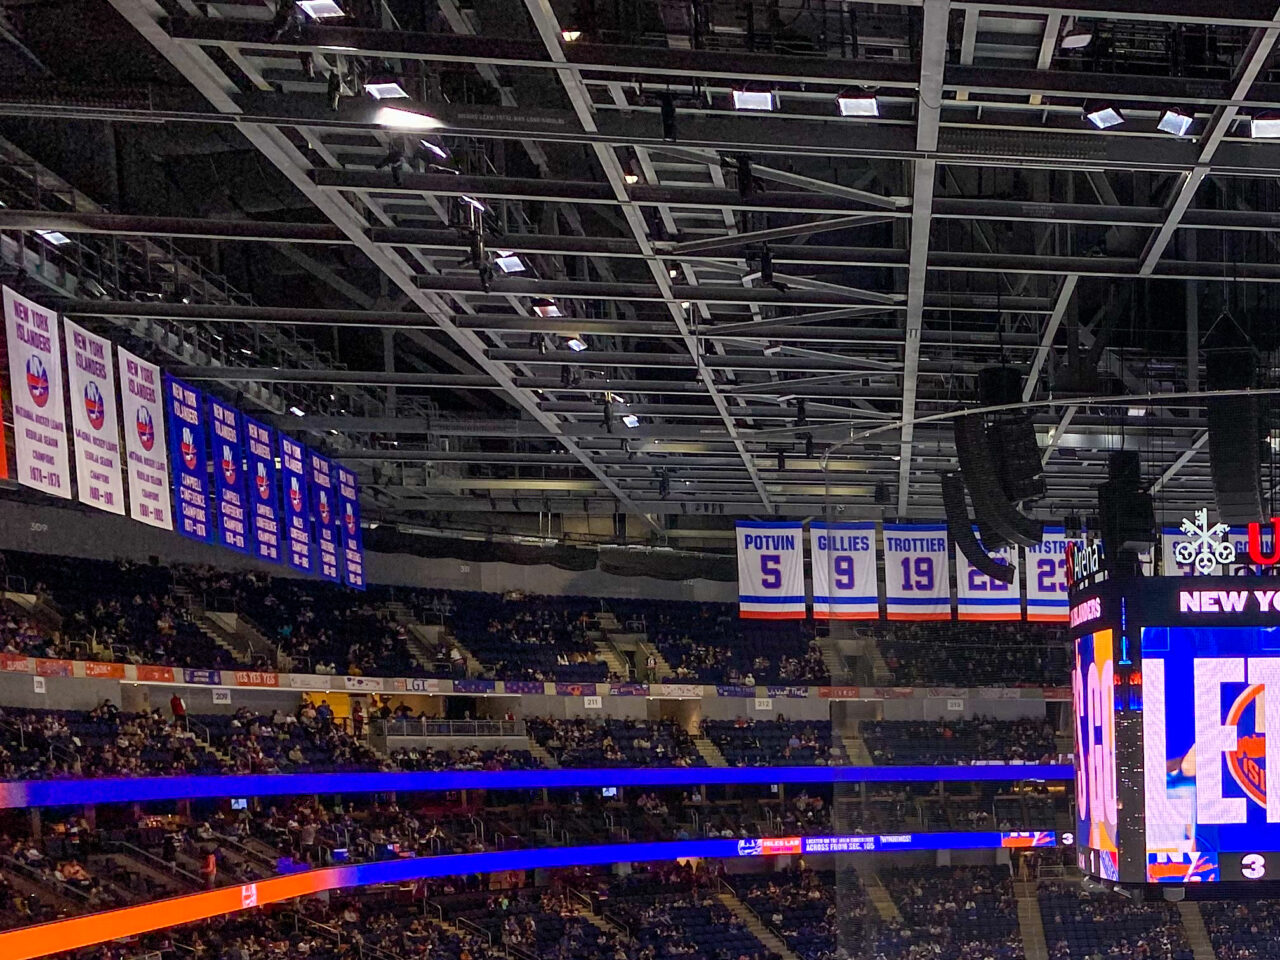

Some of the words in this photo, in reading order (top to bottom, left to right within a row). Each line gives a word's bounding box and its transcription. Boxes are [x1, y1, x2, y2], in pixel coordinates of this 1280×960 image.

[14, 299, 29, 322] NEW
[31, 309, 49, 332] YORK
[16, 322, 51, 354] ISLANDERS
[73, 330, 86, 352] NEW
[88, 339, 104, 360] YORK
[75, 351, 107, 380] ISLANDERS
[126, 358, 138, 378] NEW
[140, 365, 155, 386] YORK
[128, 377, 156, 404] ISLANDERS
[744, 534, 795, 552] POTVIN
[817, 535, 870, 552] GILLIES
[887, 537, 946, 553] TROTTIER
[760, 554, 781, 589] 5
[834, 555, 855, 590] 9
[901, 557, 934, 591] 19
[1179, 591, 1249, 612] NEW
[236, 671, 248, 683] YES
[250, 672, 261, 684] YES
[262, 673, 275, 684] YES
[215, 692, 228, 701] 209
[830, 843, 848, 851] FROM
[1062, 832, 1074, 845] 3
[1241, 853, 1266, 879] 3
